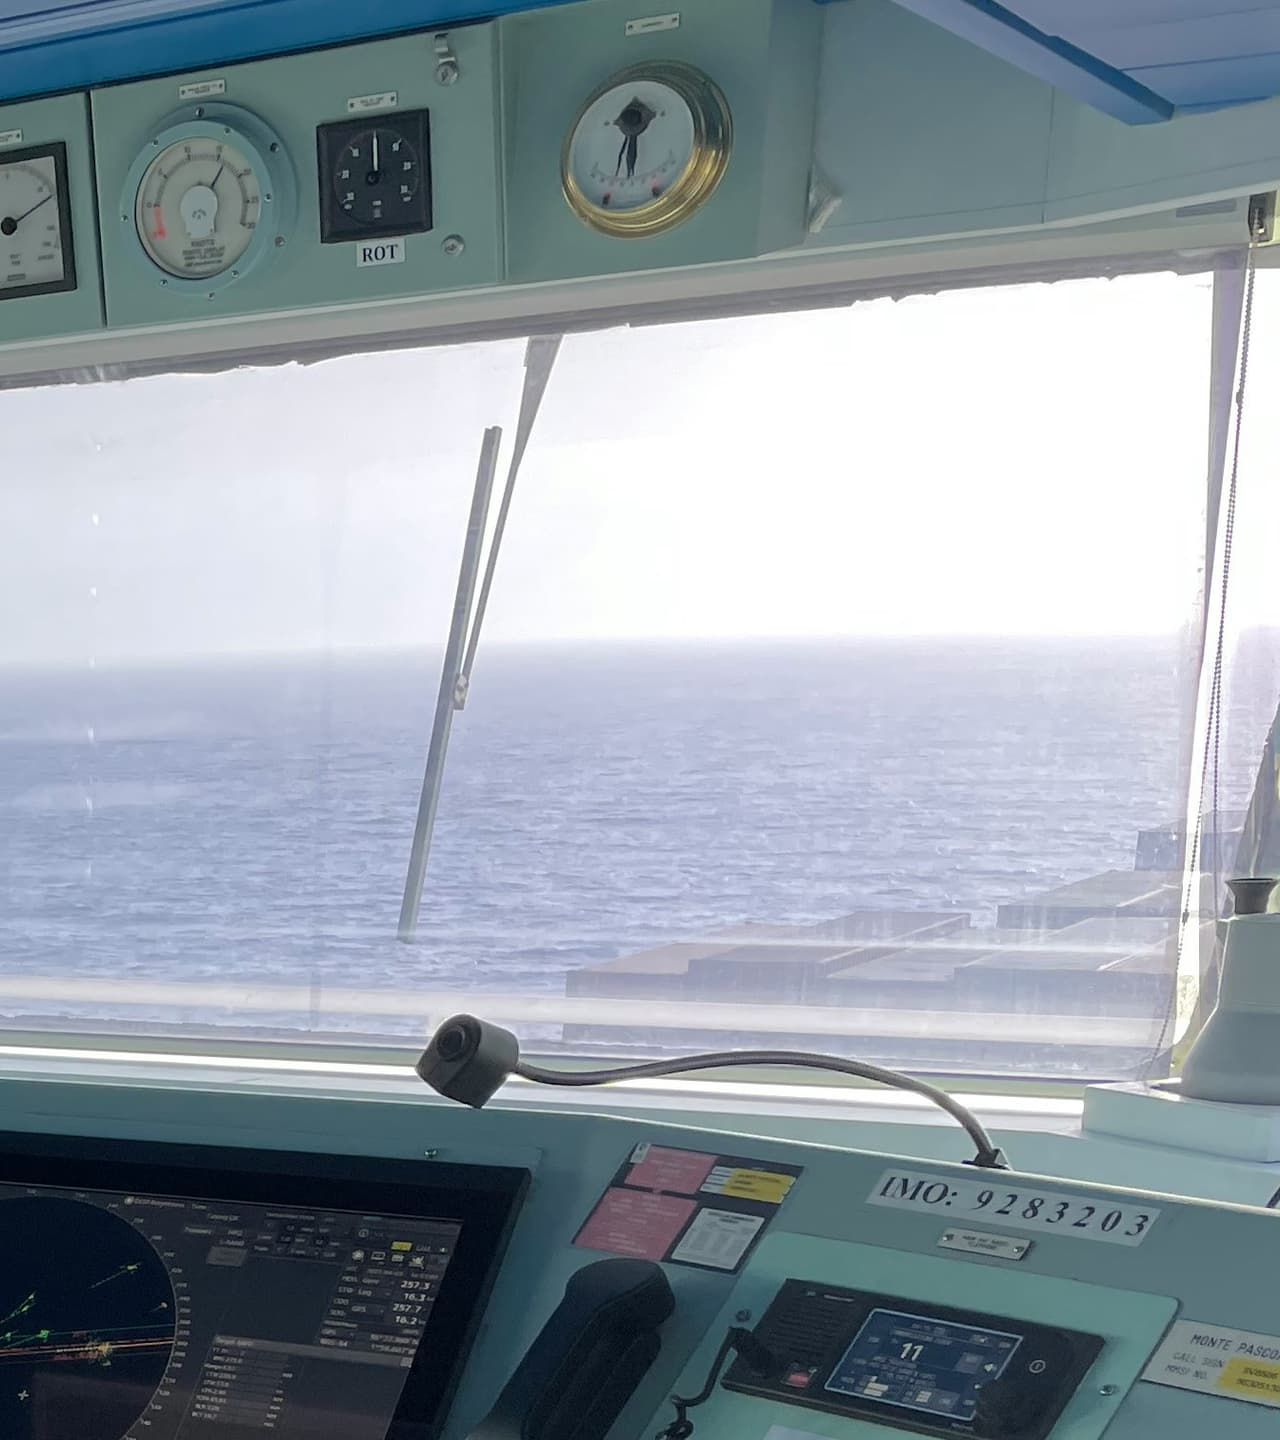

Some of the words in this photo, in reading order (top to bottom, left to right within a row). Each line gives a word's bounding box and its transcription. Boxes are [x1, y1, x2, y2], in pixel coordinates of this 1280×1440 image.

[362, 244, 399, 263] ROT
[879, 1175, 958, 1206] IMO:
[969, 1189, 1150, 1237] 9283203
[400, 1280, 431, 1290] 257.3
[899, 1342, 925, 1362] 11
[1189, 1333, 1233, 1352] MONTE
[1172, 1351, 1197, 1364] CALL
